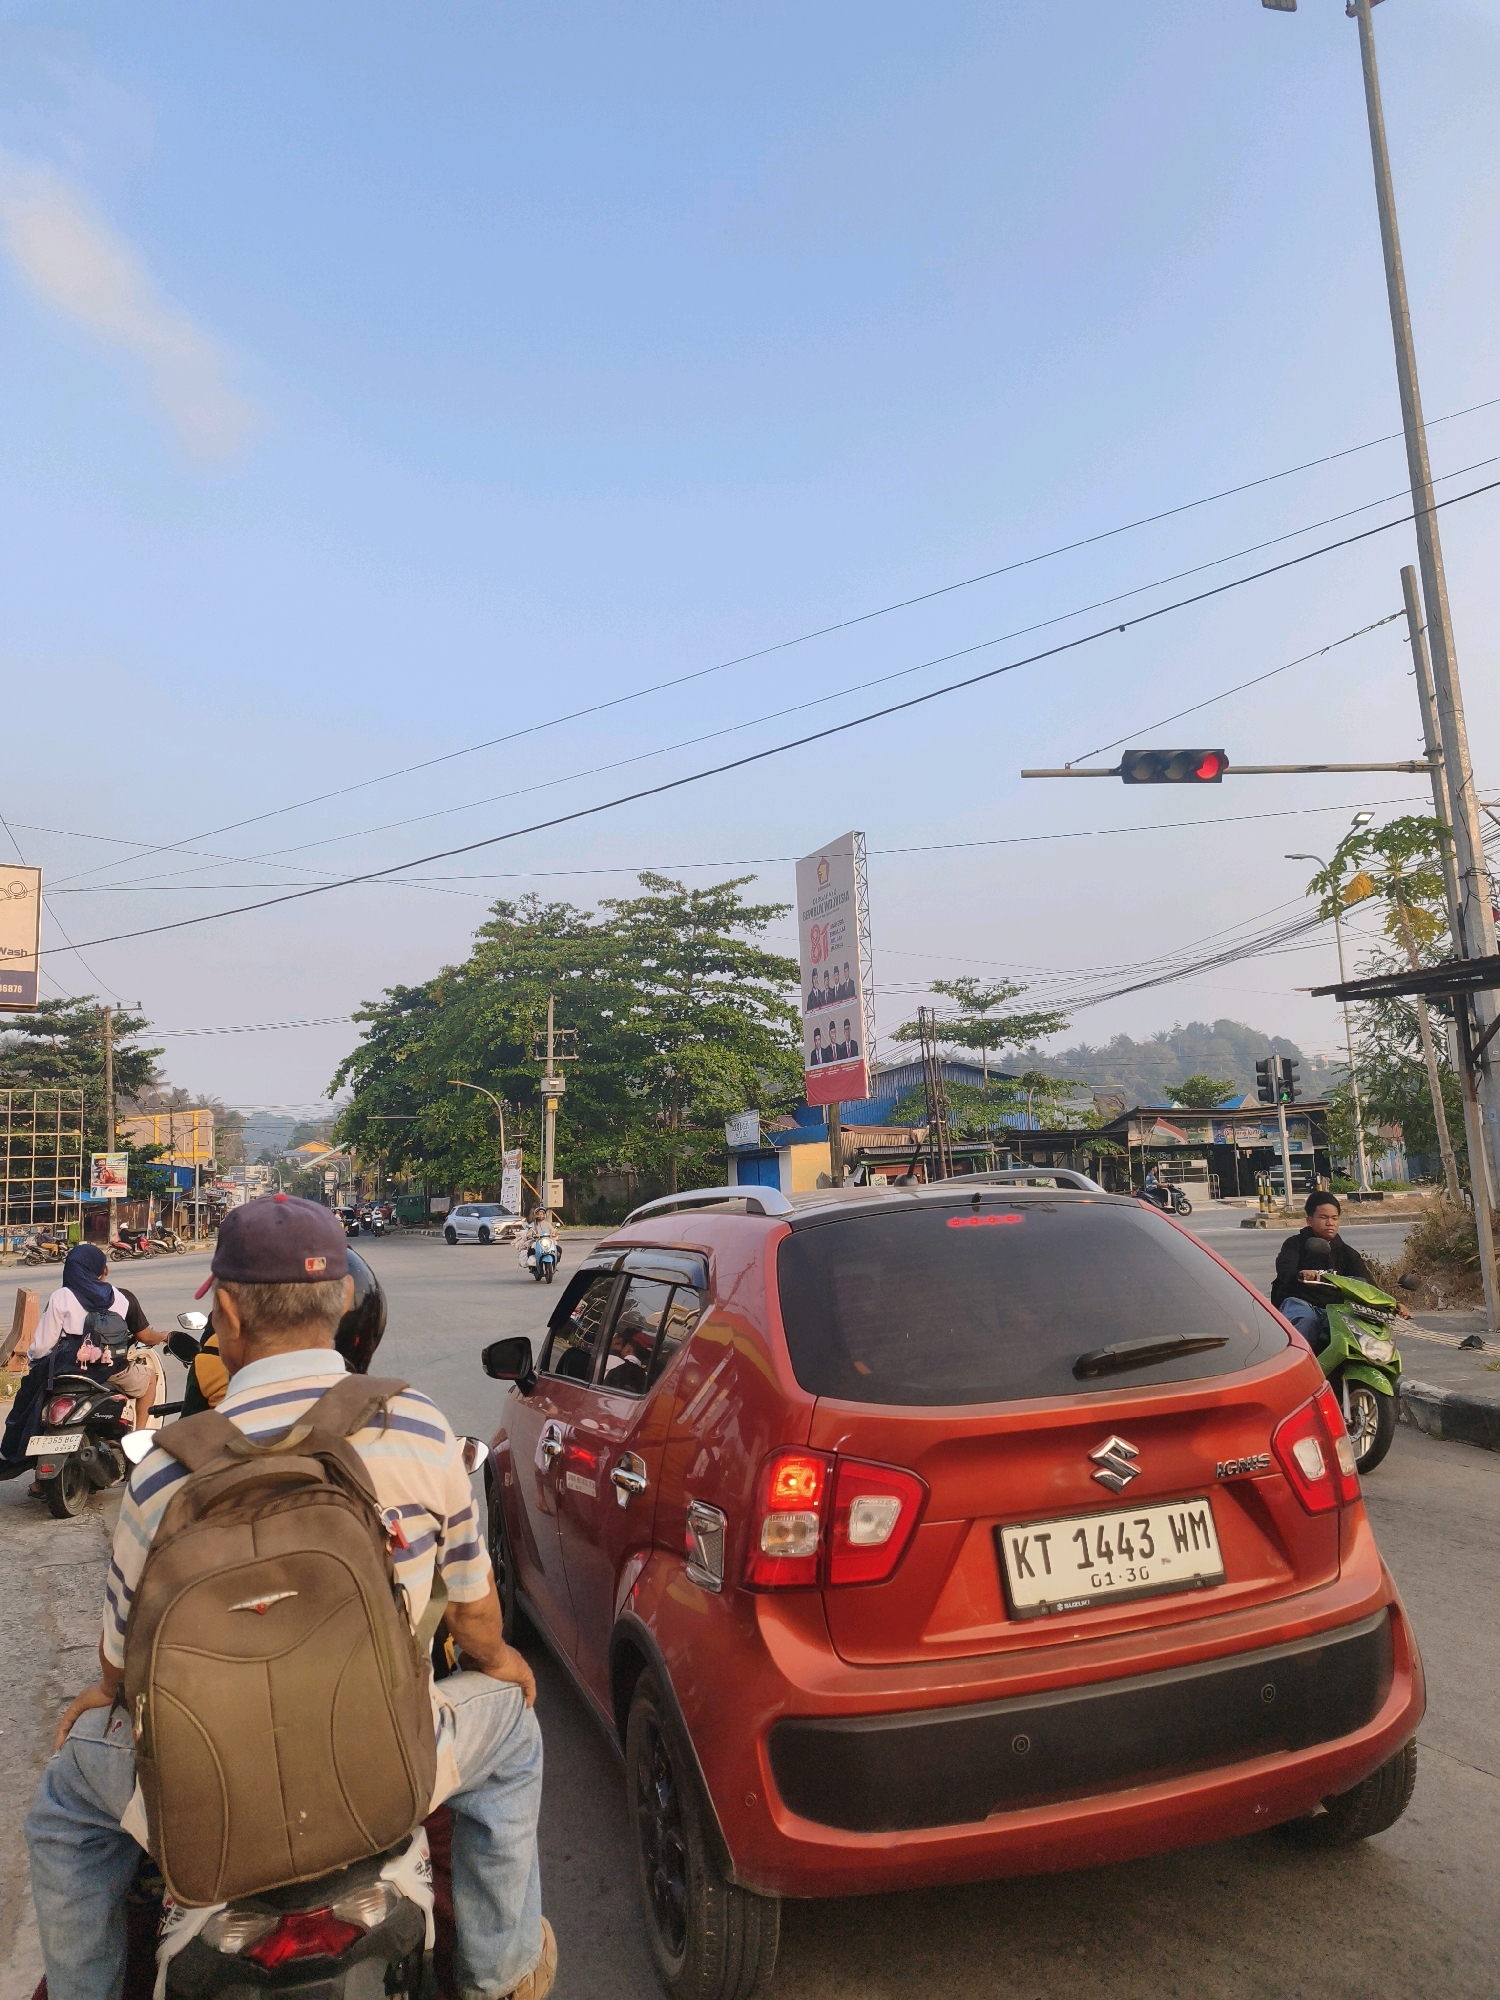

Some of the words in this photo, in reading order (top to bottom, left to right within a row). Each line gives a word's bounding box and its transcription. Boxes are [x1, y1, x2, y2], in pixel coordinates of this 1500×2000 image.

[1216, 1452, 1271, 1479] IGNIS
[1012, 1533, 1052, 1579] KT
[1072, 1518, 1155, 1570] 1443
[1167, 1509, 1211, 1554] WM
[1063, 1599, 1090, 1609] SUZUKI
